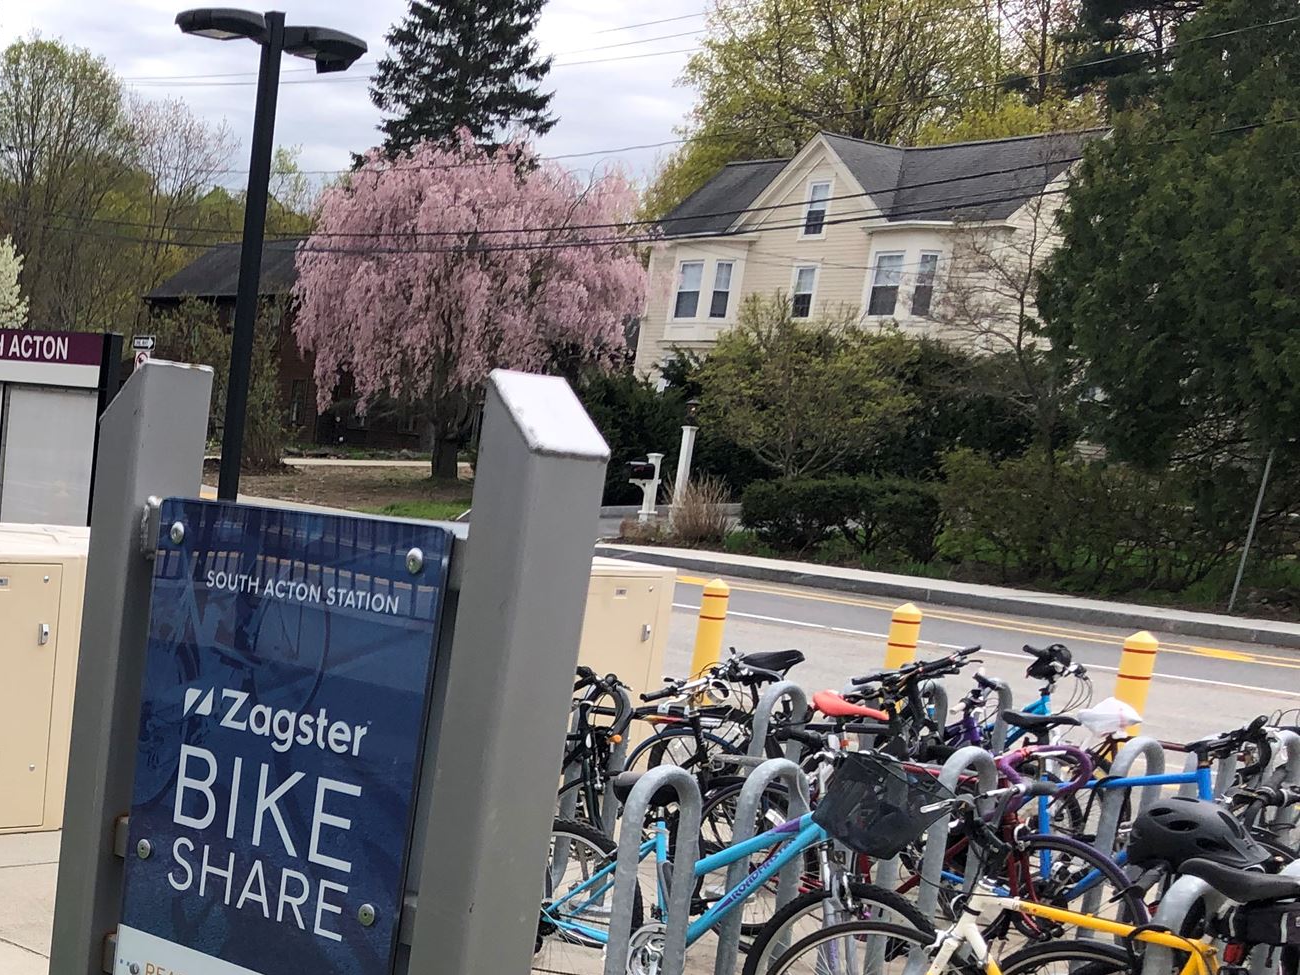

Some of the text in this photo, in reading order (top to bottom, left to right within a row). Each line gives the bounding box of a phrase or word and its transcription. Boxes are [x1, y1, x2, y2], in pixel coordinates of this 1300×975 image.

[9, 334, 68, 360] ACTON
[206, 570, 400, 615] SOUTH ACTON STATION
[220, 688, 368, 756] Zagster
[173, 743, 362, 873] BIKE
[168, 836, 349, 942] SHARE
